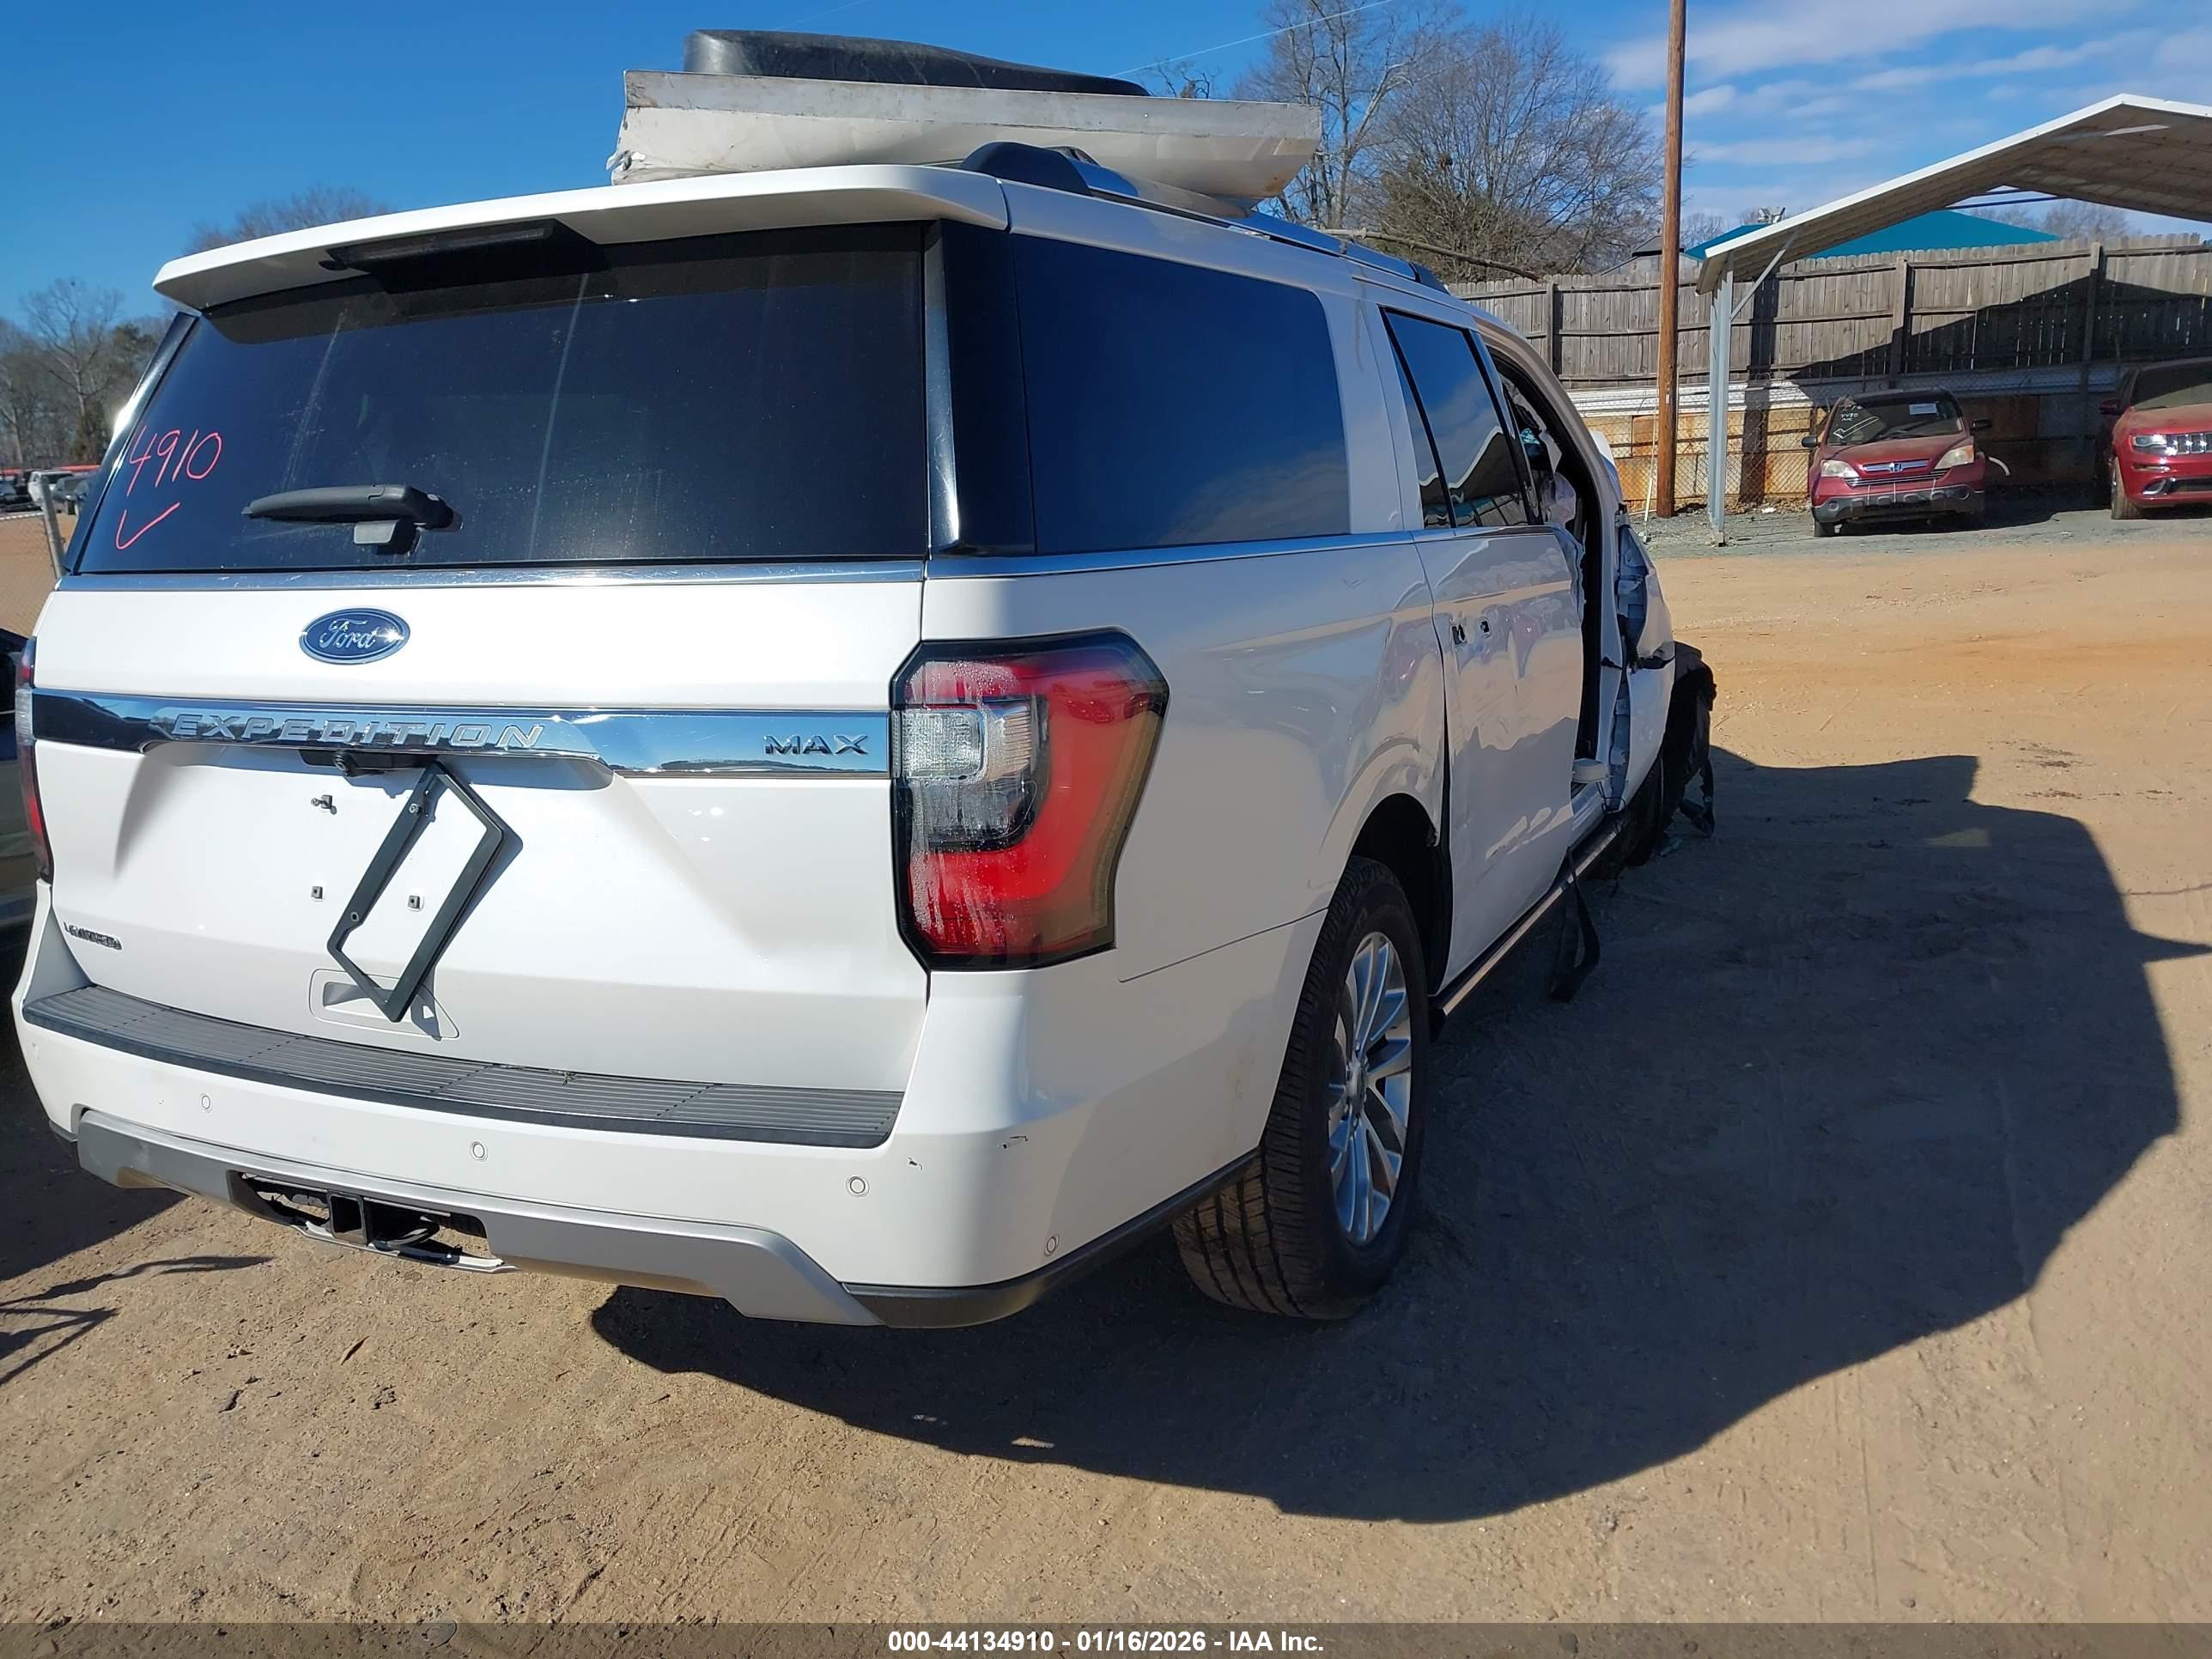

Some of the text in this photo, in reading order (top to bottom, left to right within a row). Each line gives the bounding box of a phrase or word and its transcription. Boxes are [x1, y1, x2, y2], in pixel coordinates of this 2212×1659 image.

[125, 425, 222, 497] 4910
[319, 617, 380, 648] Ford
[172, 714, 545, 749] EXPEDITION
[763, 734, 869, 756] MAX
